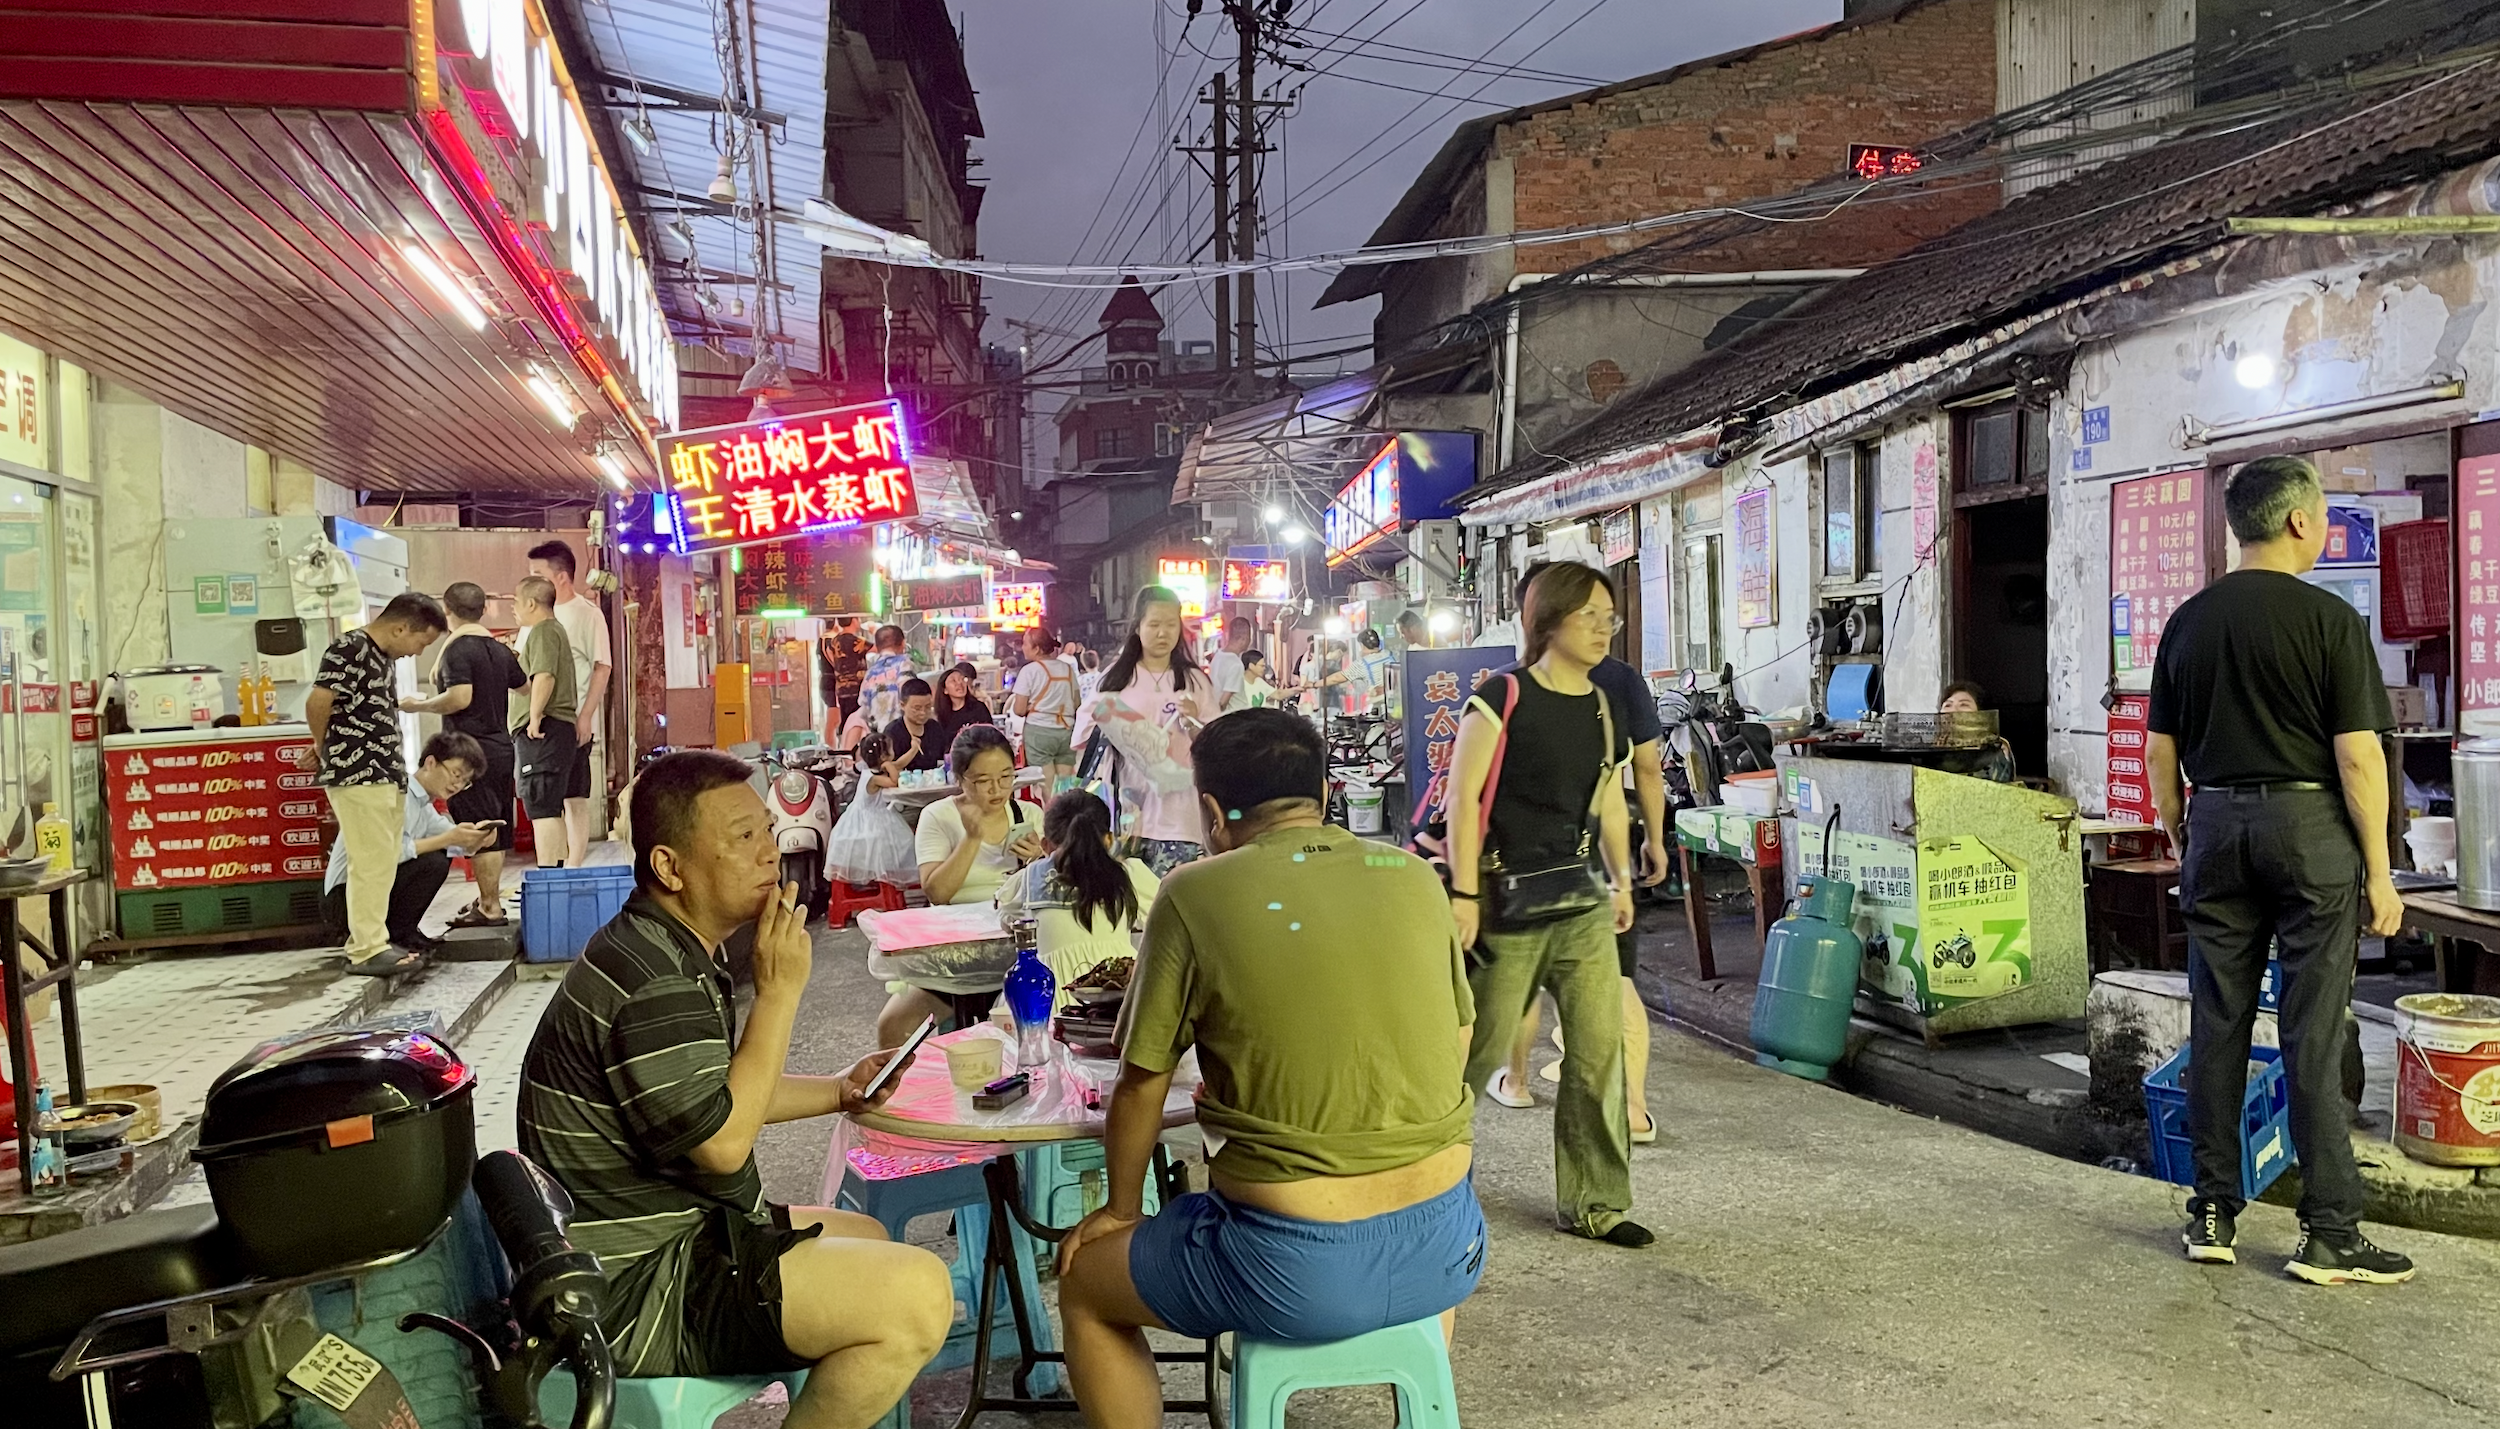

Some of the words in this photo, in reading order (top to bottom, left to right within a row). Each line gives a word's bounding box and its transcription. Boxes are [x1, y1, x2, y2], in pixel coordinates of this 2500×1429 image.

[2085, 421, 2101, 441] 190
[719, 415, 899, 483] 油焖大虾
[730, 466, 908, 536] 清水蒸虾
[1738, 501, 1767, 618] 海鲜
[201, 750, 241, 769] 100%
[242, 751, 265, 764] 中奖
[202, 776, 243, 796] 100%
[244, 779, 267, 791] 中奖
[204, 805, 245, 823] 100%
[246, 806, 268, 819] 中奖
[206, 832, 247, 851] 100%
[248, 835, 271, 847] 中奖
[208, 861, 249, 879] 100%
[250, 862, 273, 875] 中奖
[1974, 874, 2017, 895] 抽红包
[327, 1339, 344, 1351] S
